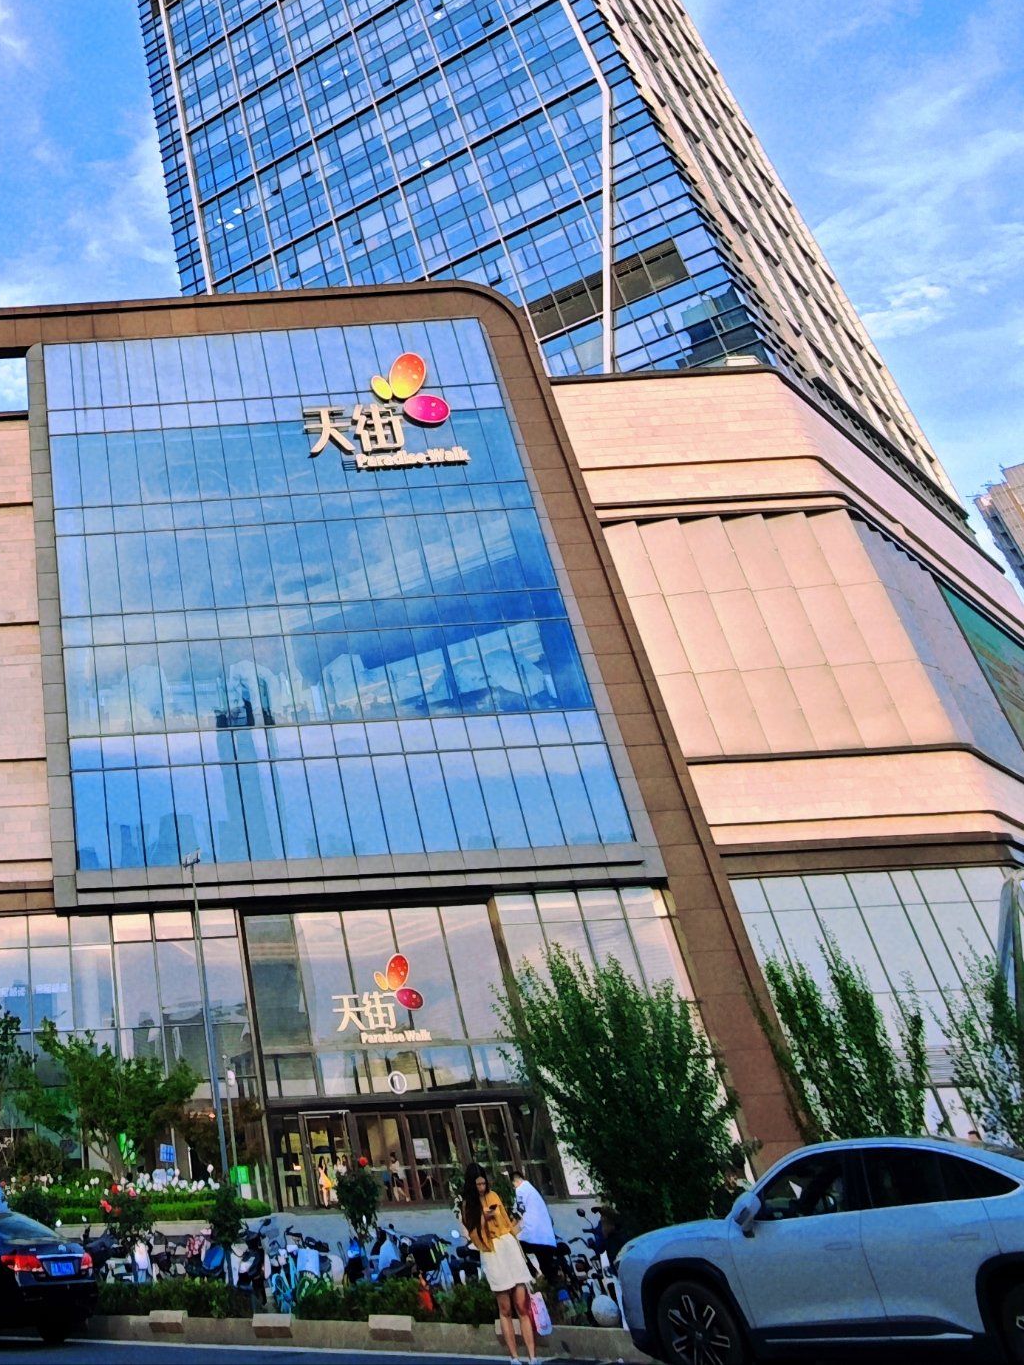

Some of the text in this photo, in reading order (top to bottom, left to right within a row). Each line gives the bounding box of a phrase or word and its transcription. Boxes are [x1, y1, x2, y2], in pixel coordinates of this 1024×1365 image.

[303, 403, 405, 454] 天街
[355, 446, 470, 470] Paradise Walk
[331, 991, 397, 1032] 天街
[360, 1029, 432, 1044] Paradise Walk
